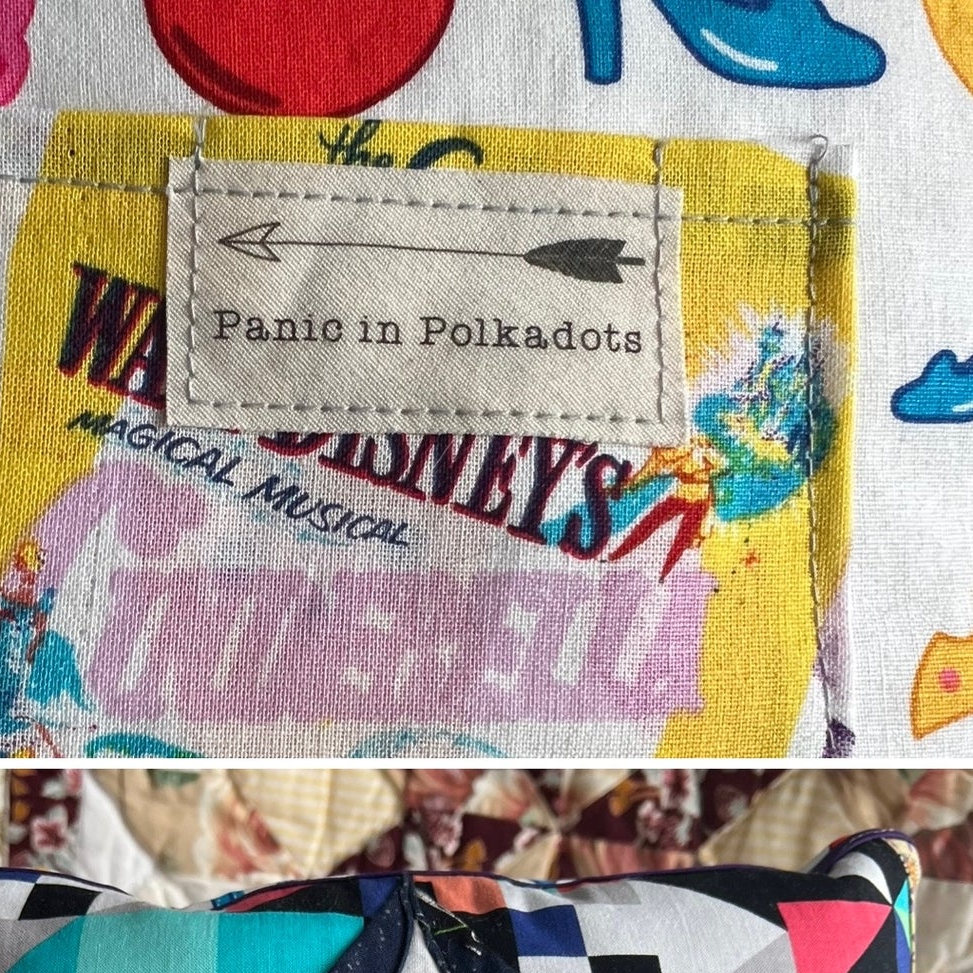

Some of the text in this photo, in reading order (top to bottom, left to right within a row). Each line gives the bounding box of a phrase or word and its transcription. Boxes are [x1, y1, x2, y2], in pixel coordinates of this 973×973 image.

[211, 309, 644, 355] Panic in Polkadots
[66, 409, 410, 547] MAGICAL MUSICAL
